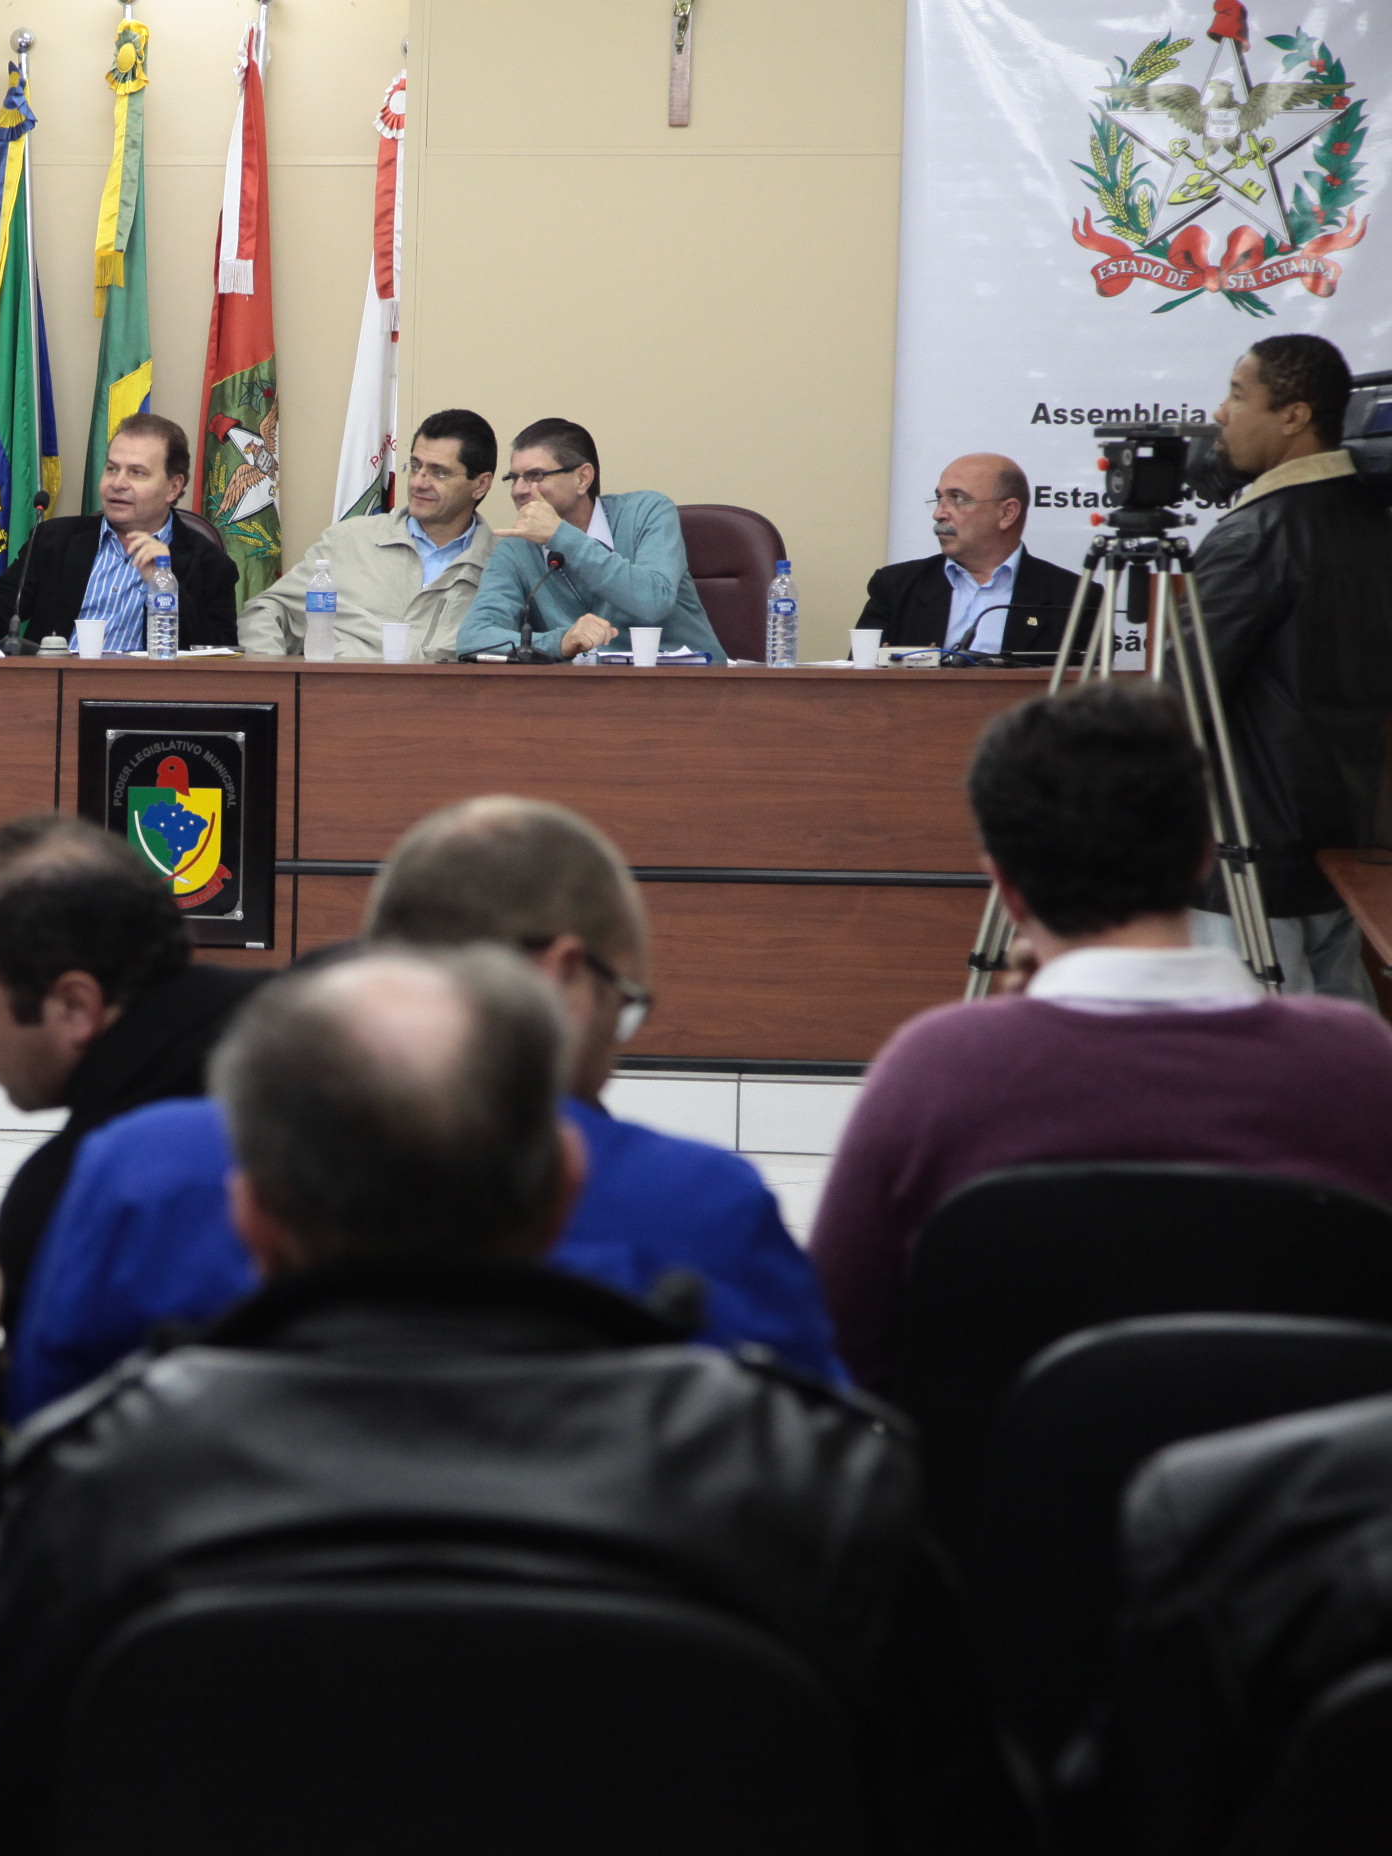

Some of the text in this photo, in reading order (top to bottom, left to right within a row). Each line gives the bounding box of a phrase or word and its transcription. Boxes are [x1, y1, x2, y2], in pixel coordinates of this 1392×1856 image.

[1097, 259, 1164, 280] ESTADO
[1165, 269, 1189, 288] DE
[1030, 402, 1207, 425] Assembleia
[113, 740, 237, 808] PODER LEGISLATIVO MUNICIPAL
